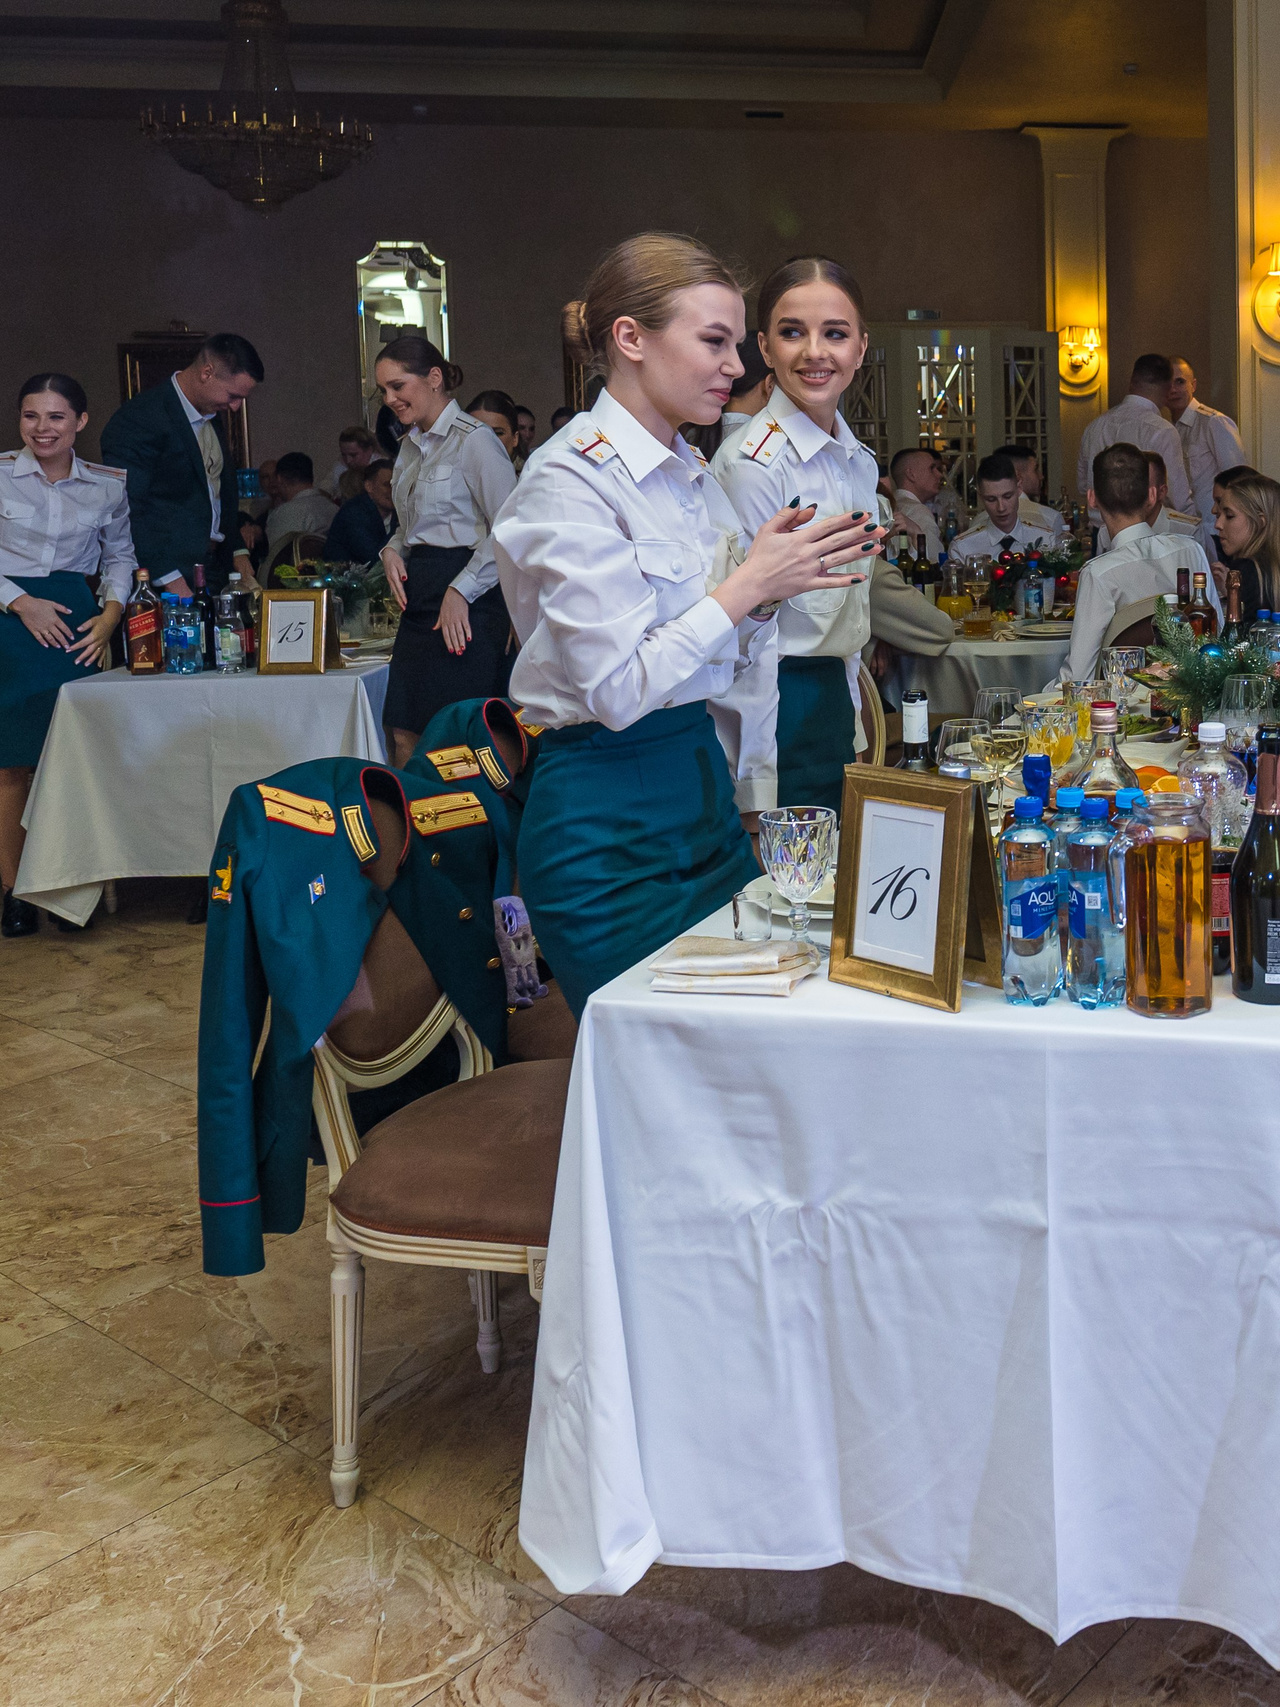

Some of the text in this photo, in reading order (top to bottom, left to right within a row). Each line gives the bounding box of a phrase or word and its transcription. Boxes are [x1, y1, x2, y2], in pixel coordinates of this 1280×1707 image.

[277, 621, 308, 644] 15
[868, 864, 930, 921] 16
[1028, 889, 1056, 907] AQU
